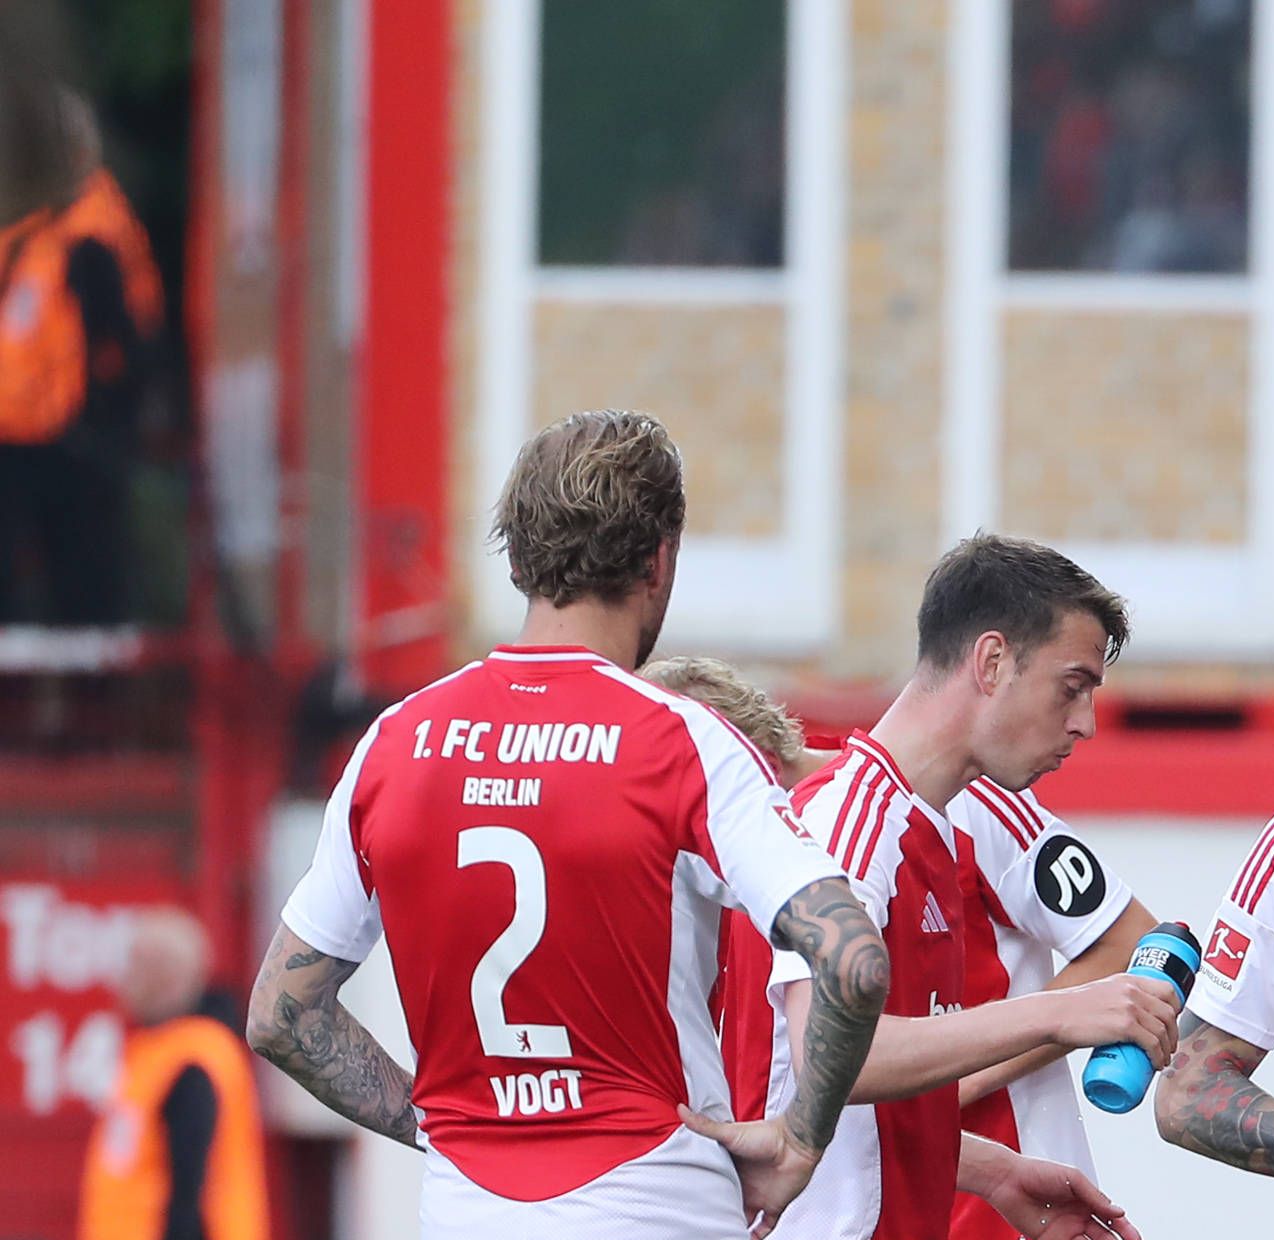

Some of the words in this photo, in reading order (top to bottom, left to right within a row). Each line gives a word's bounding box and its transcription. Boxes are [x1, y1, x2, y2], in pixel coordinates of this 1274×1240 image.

[413, 720, 432, 759] 1.
[440, 719, 492, 762] FC
[497, 723, 622, 764] UNION
[462, 777, 541, 806] BERLIN
[1048, 844, 1095, 912] JD
[457, 825, 573, 1058] 2
[1137, 947, 1171, 960] WER
[11, 1010, 126, 1115] 14
[489, 1069, 583, 1118] VOGT
